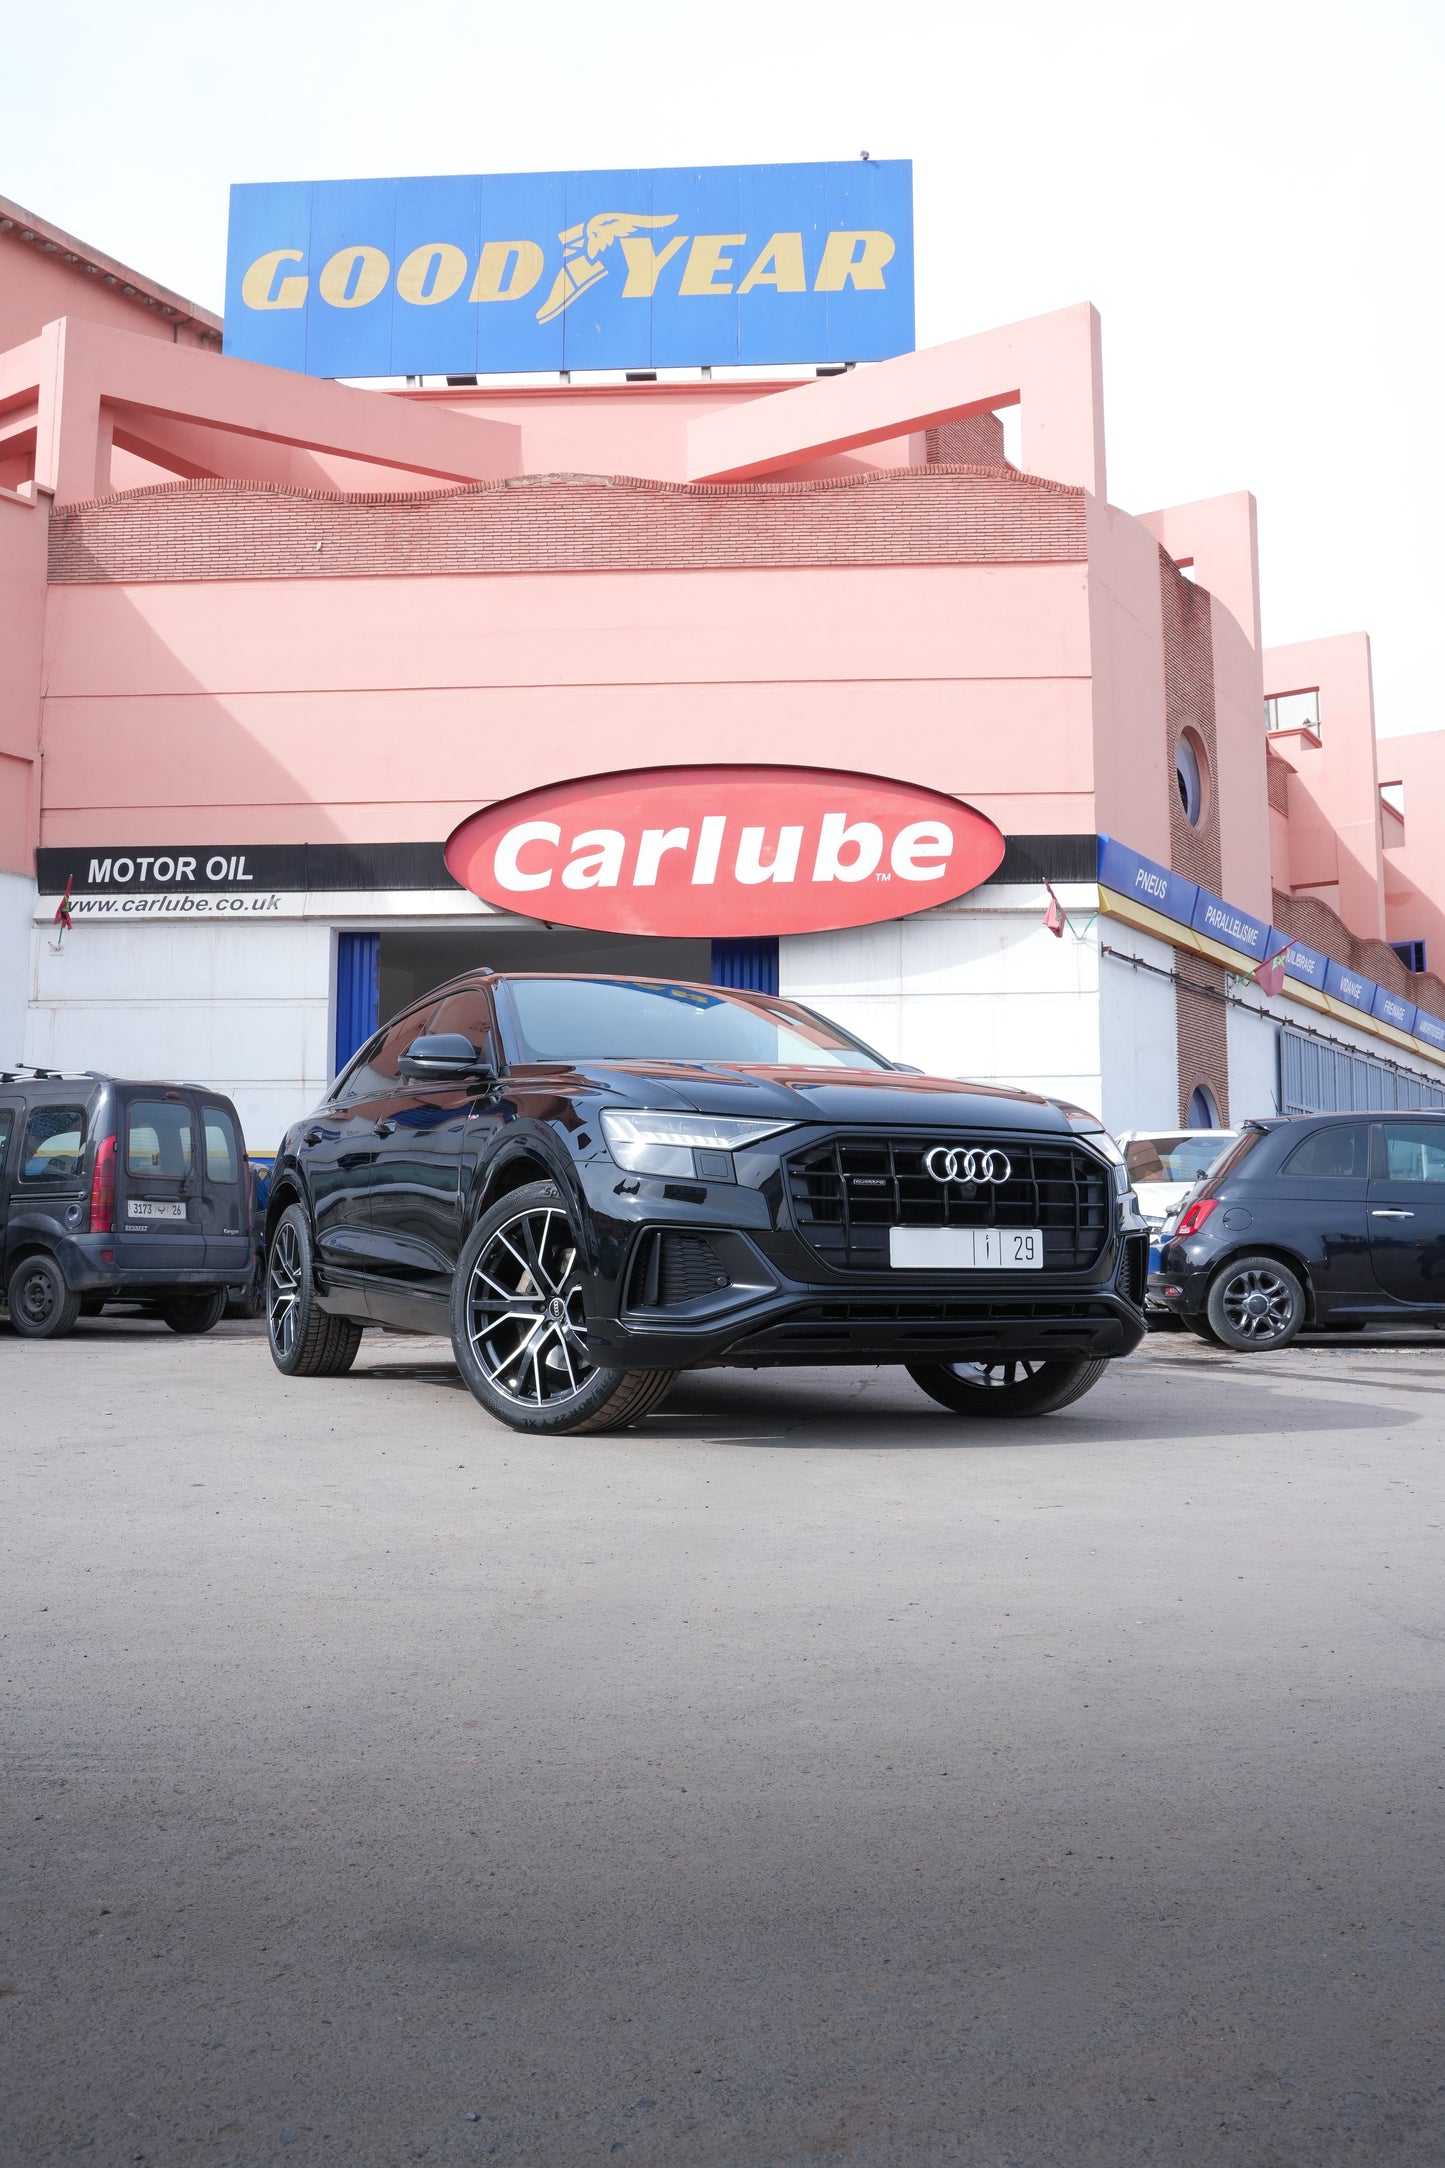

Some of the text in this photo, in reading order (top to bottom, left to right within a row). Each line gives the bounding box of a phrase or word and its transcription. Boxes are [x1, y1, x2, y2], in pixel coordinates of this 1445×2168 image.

[493, 812, 954, 892] Carlube
[88, 856, 254, 883] MOTOR OIL
[875, 872, 892, 882] TM
[1135, 868, 1168, 899] PNEUS
[1204, 905, 1259, 946] PARALLELISME
[133, 1203, 152, 1215] 3173
[172, 1205, 182, 1216] 26
[1013, 1236, 1035, 1260] 29
